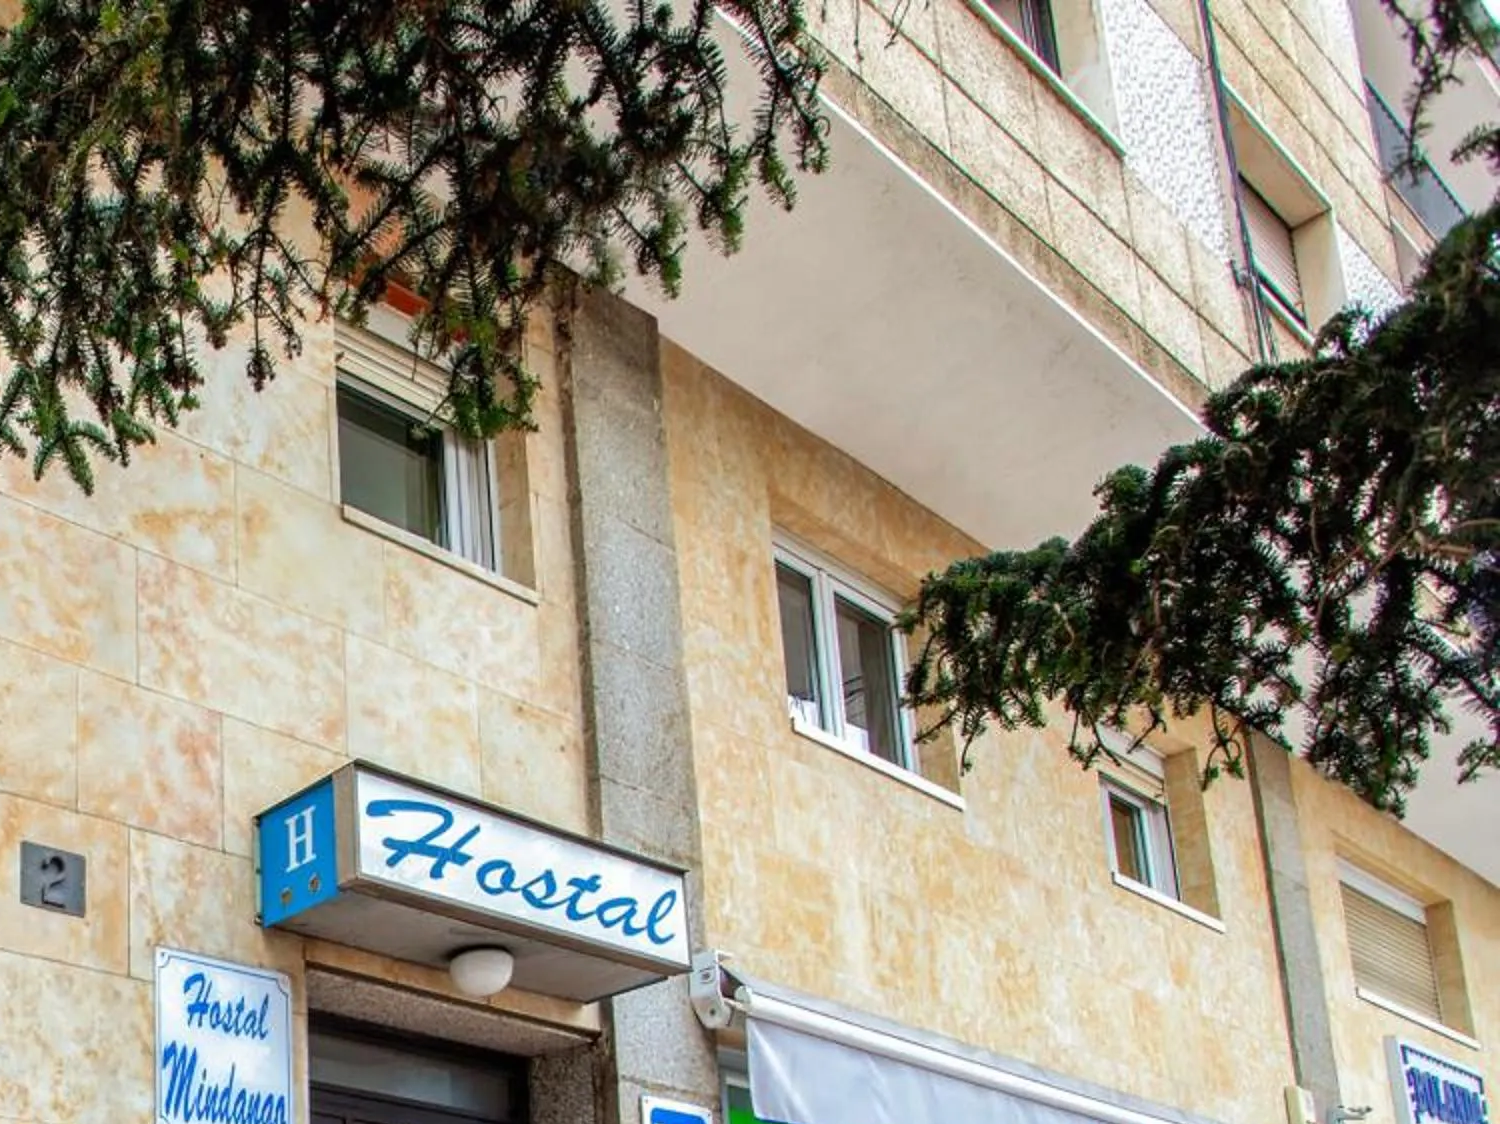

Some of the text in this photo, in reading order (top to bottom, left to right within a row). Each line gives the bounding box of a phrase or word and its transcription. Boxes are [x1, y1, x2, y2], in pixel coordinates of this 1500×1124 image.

[284, 806, 317, 873] H
[365, 799, 677, 946] Hostal
[40, 855, 67, 909] 2
[183, 972, 269, 1040] Hostal
